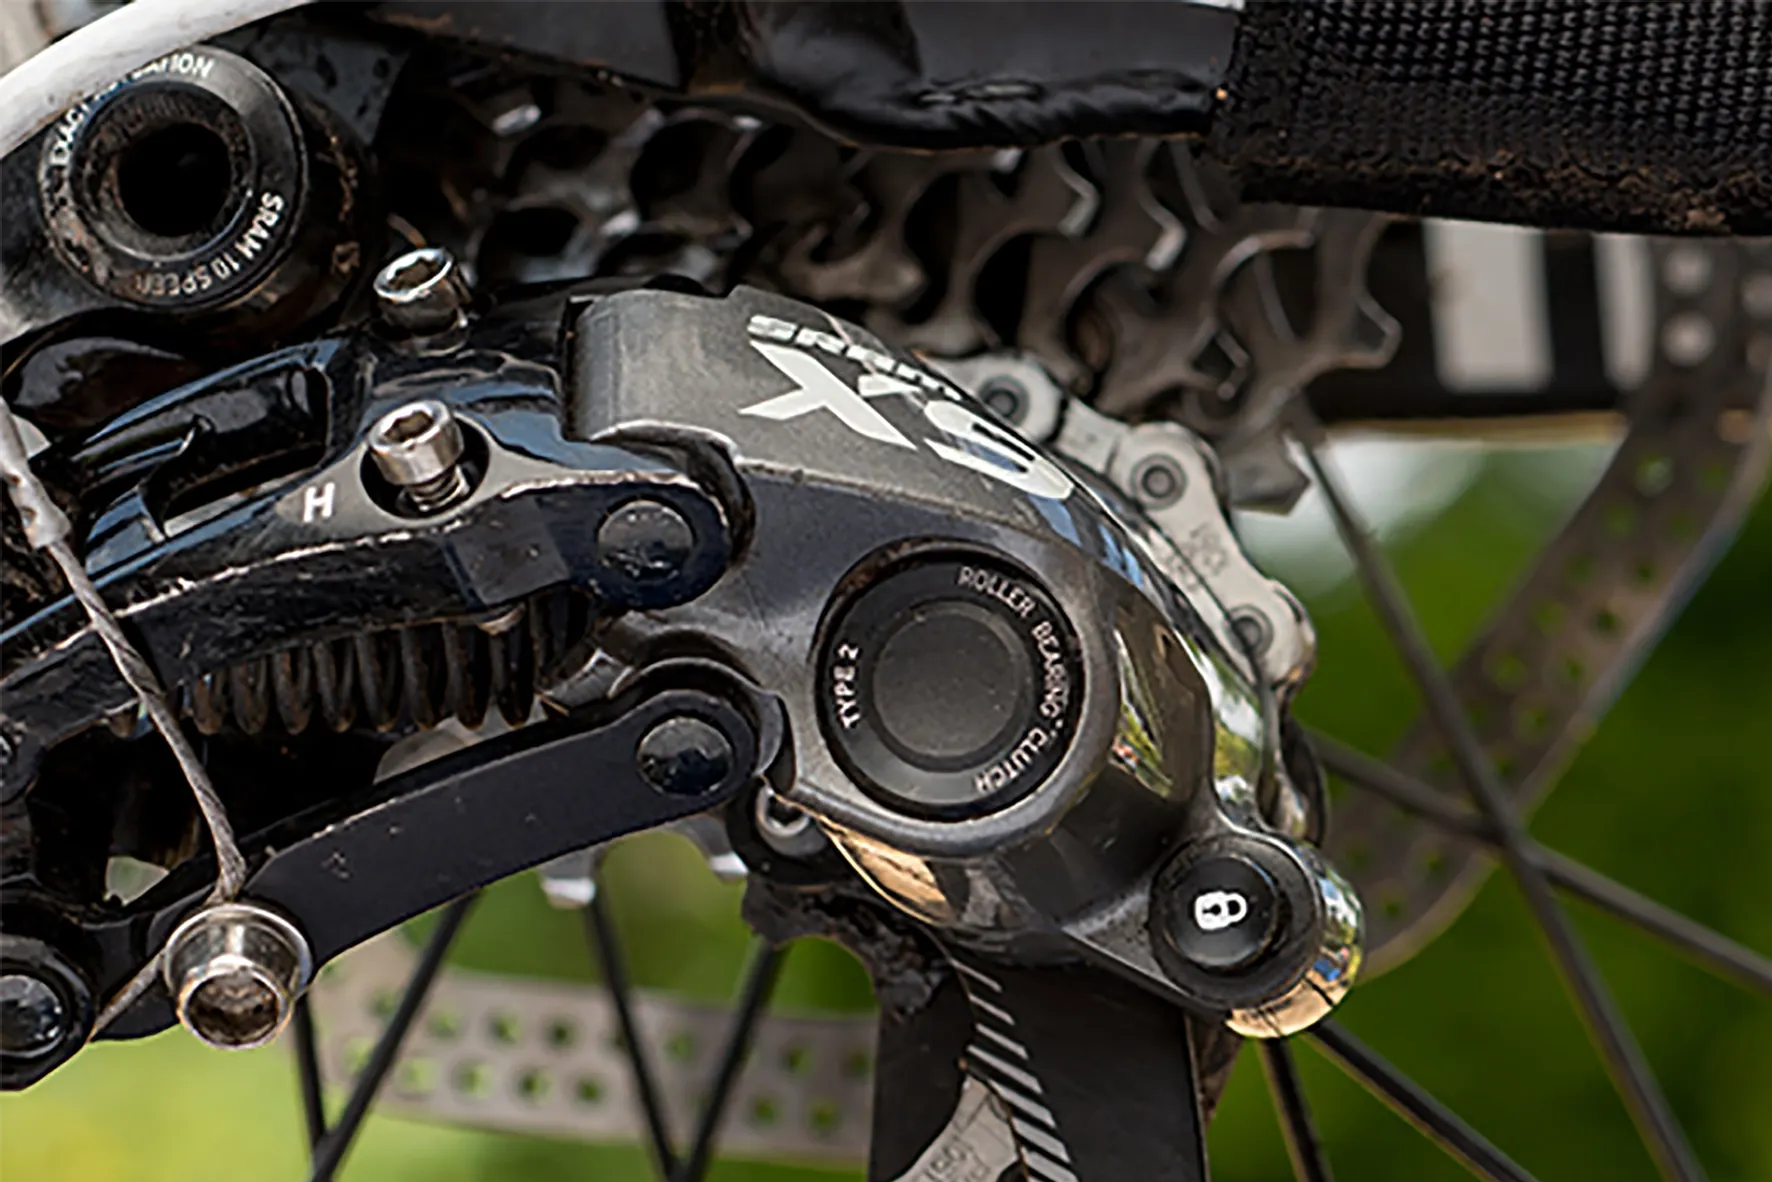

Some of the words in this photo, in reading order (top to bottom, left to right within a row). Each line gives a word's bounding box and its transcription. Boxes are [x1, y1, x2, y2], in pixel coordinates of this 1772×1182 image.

[235, 191, 284, 260] SRAM
[303, 482, 335, 523] H
[957, 566, 1036, 618] ROLLER
[838, 644, 859, 660] 2
[834, 666, 860, 728] TYPE
[975, 727, 1048, 794] CLUTCH
